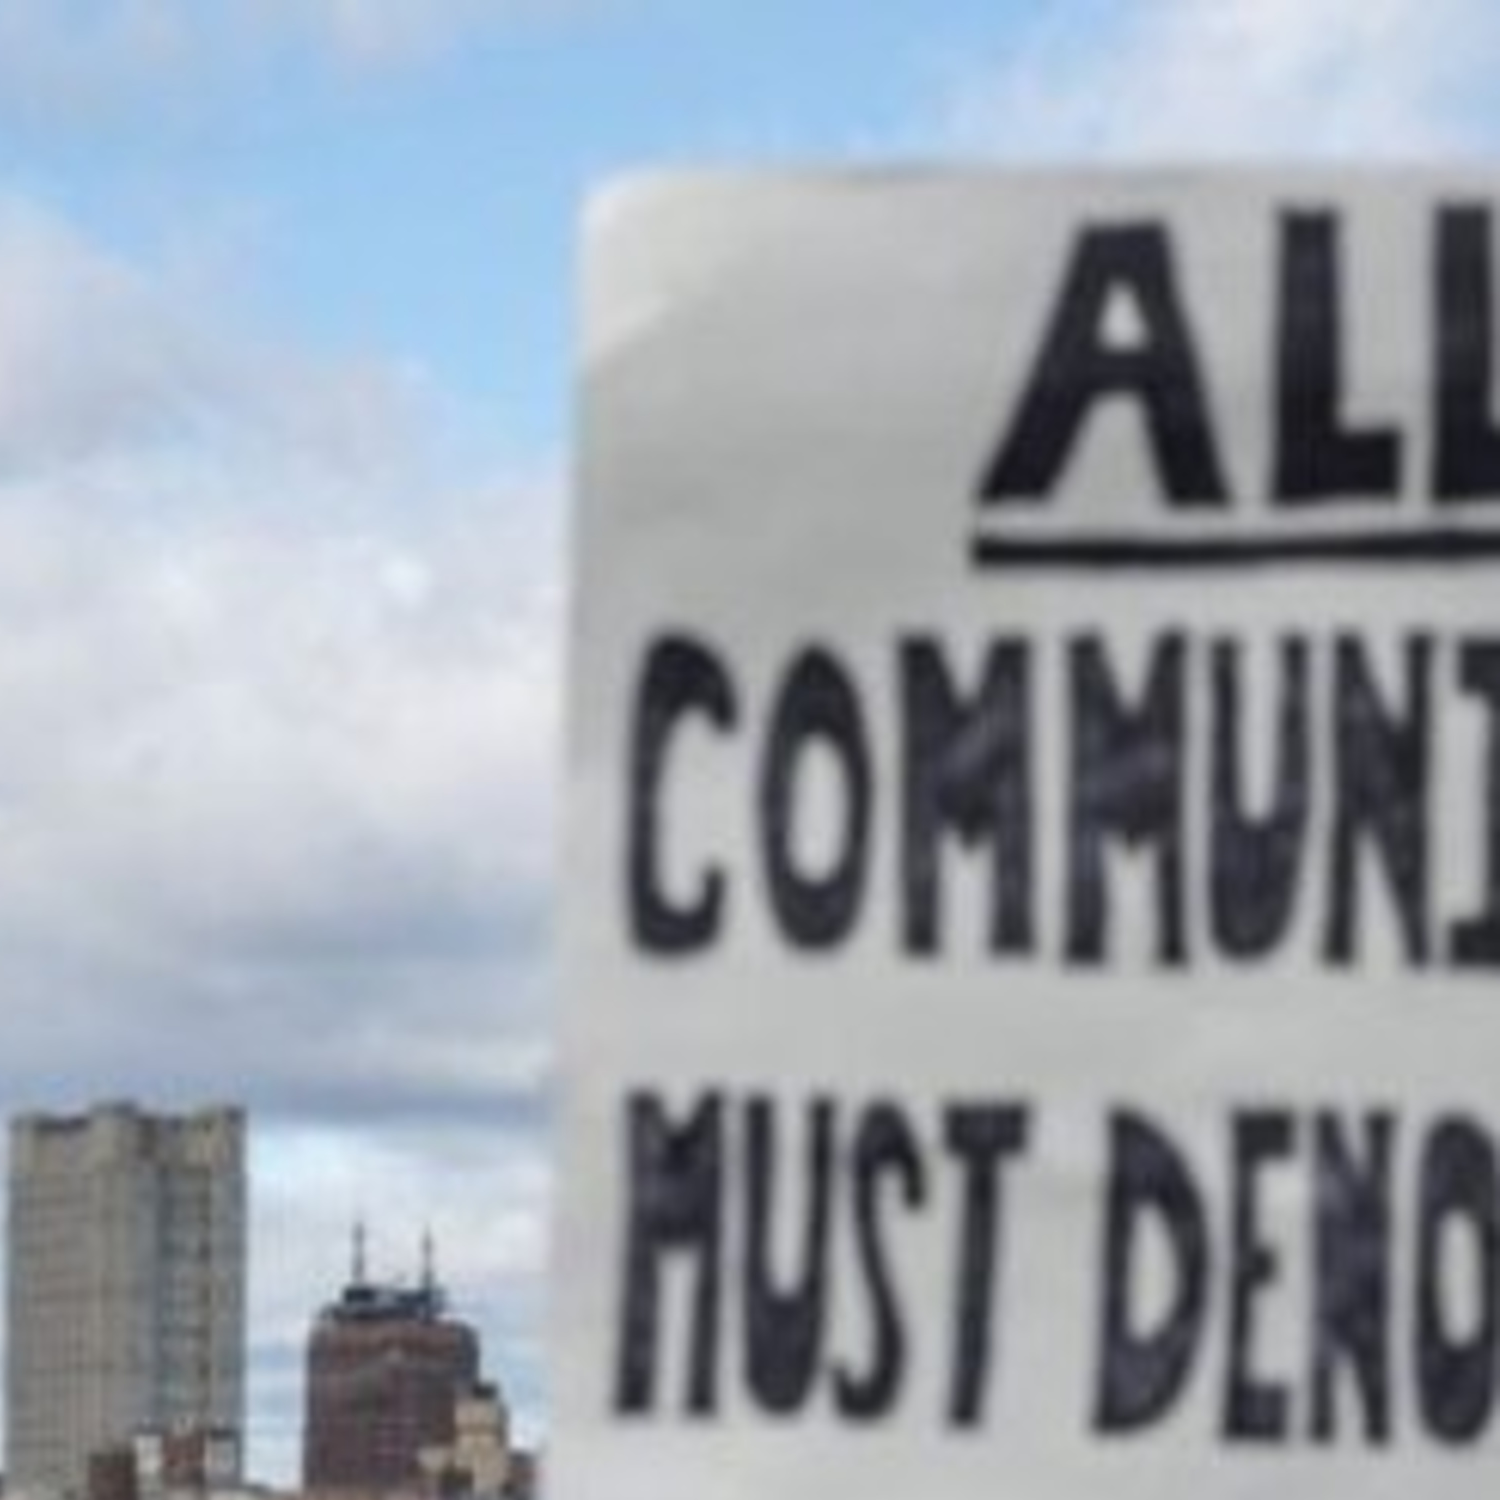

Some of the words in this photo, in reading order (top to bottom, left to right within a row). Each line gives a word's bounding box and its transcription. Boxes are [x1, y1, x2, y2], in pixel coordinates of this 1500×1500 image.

[973, 200, 1500, 513] ALL
[612, 1088, 1031, 1430] MUST
[1090, 1106, 1500, 1448] DENO
